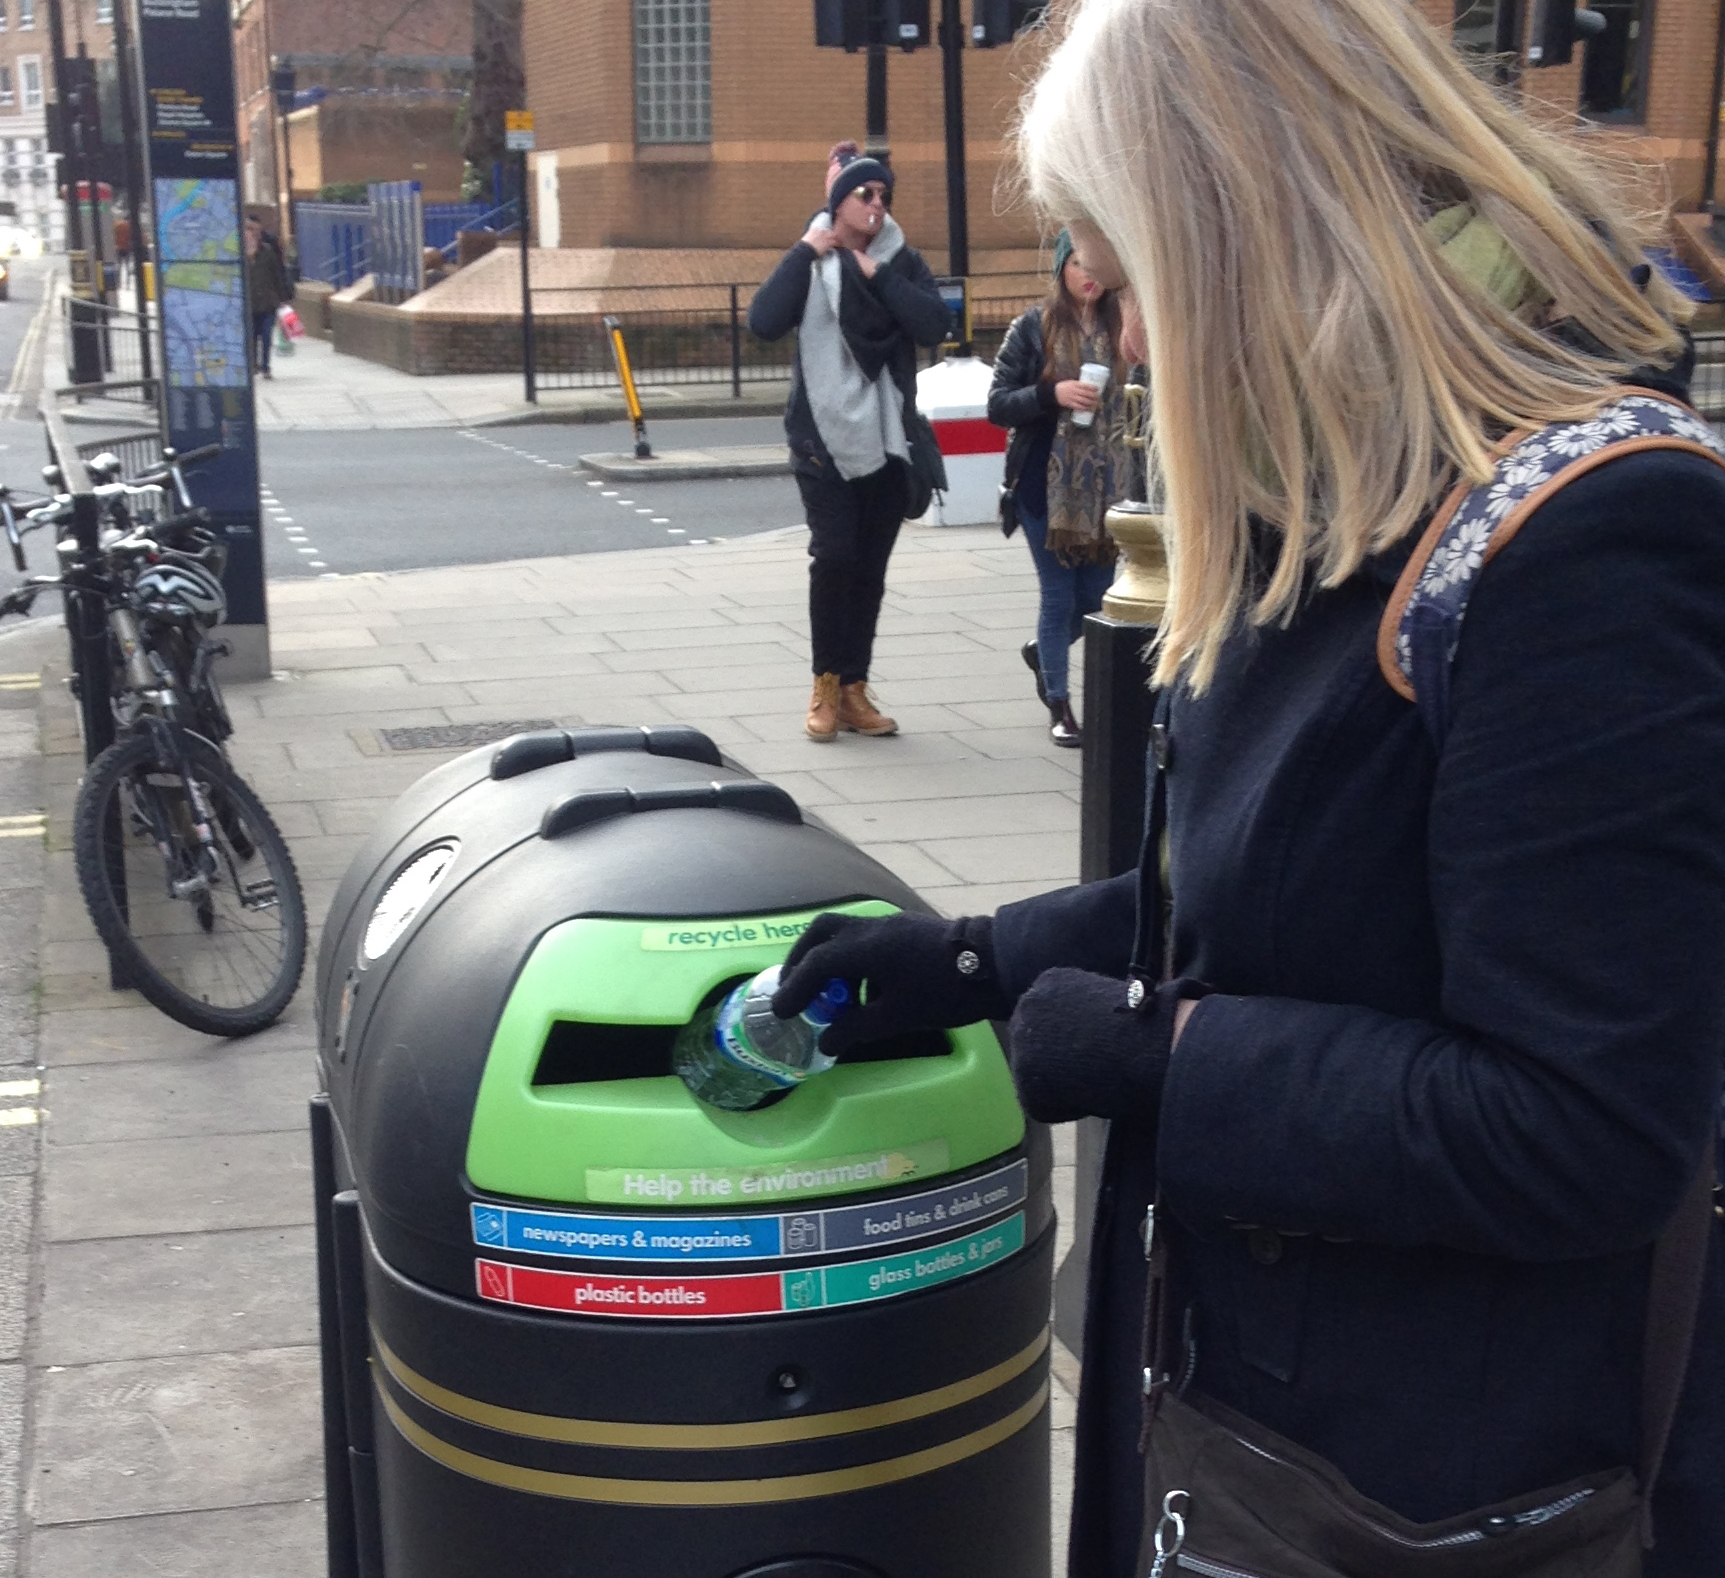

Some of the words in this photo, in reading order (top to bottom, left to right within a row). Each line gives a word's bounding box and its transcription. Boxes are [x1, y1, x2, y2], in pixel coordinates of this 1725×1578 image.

[668, 924, 757, 947] recycle
[623, 1174, 683, 1201] Help
[690, 1174, 732, 1196] the
[739, 1155, 888, 1194] environment
[863, 1214, 900, 1235] food
[905, 1212, 931, 1228] tins
[934, 1204, 947, 1220] &
[949, 1192, 982, 1215] drink
[983, 1185, 1008, 1205] cans
[522, 1226, 628, 1247] newspapers
[631, 1230, 648, 1247] &
[651, 1231, 751, 1251] magazines
[869, 1266, 911, 1290] glass
[915, 1252, 965, 1277] bottles
[968, 1243, 979, 1260] &
[980, 1235, 1003, 1259] jars
[574, 1283, 634, 1305] plastic
[638, 1285, 707, 1305] bottles
